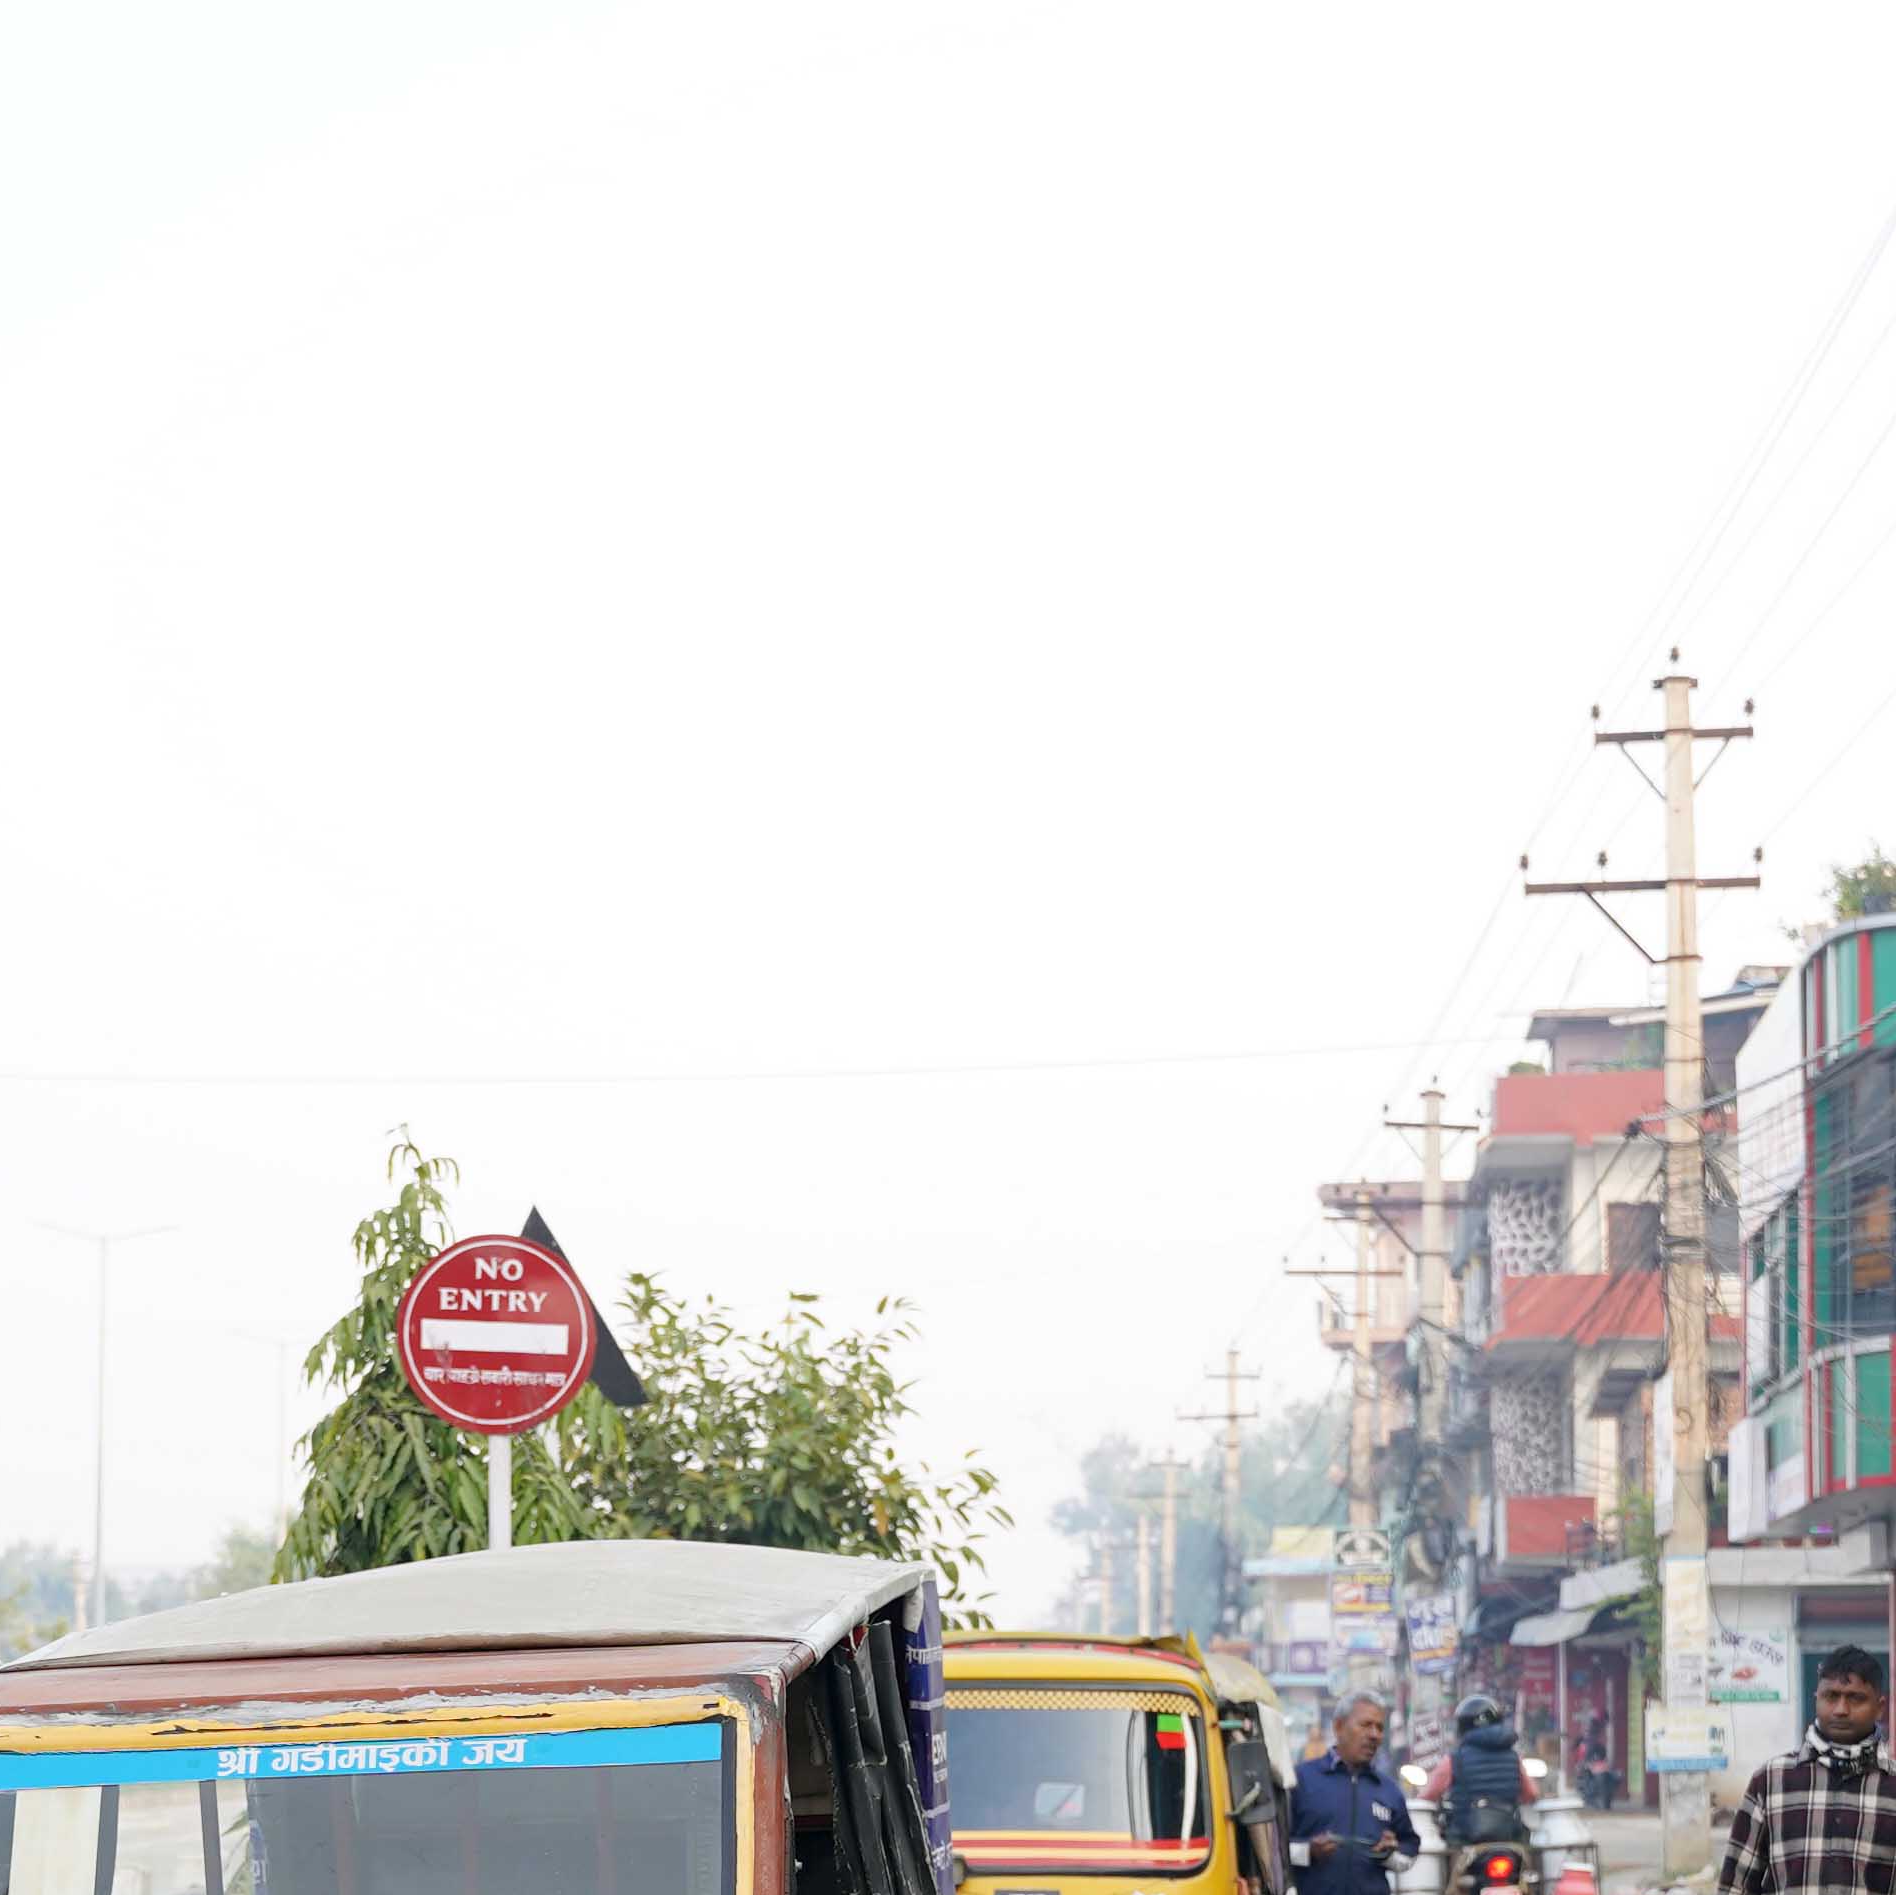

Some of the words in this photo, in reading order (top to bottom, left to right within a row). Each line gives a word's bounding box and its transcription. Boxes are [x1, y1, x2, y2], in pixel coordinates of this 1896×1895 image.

[475, 1257, 524, 1281] NO
[438, 1287, 548, 1313] ENTRY
[216, 1747, 259, 1777] श्री
[461, 1737, 529, 1766] जय
